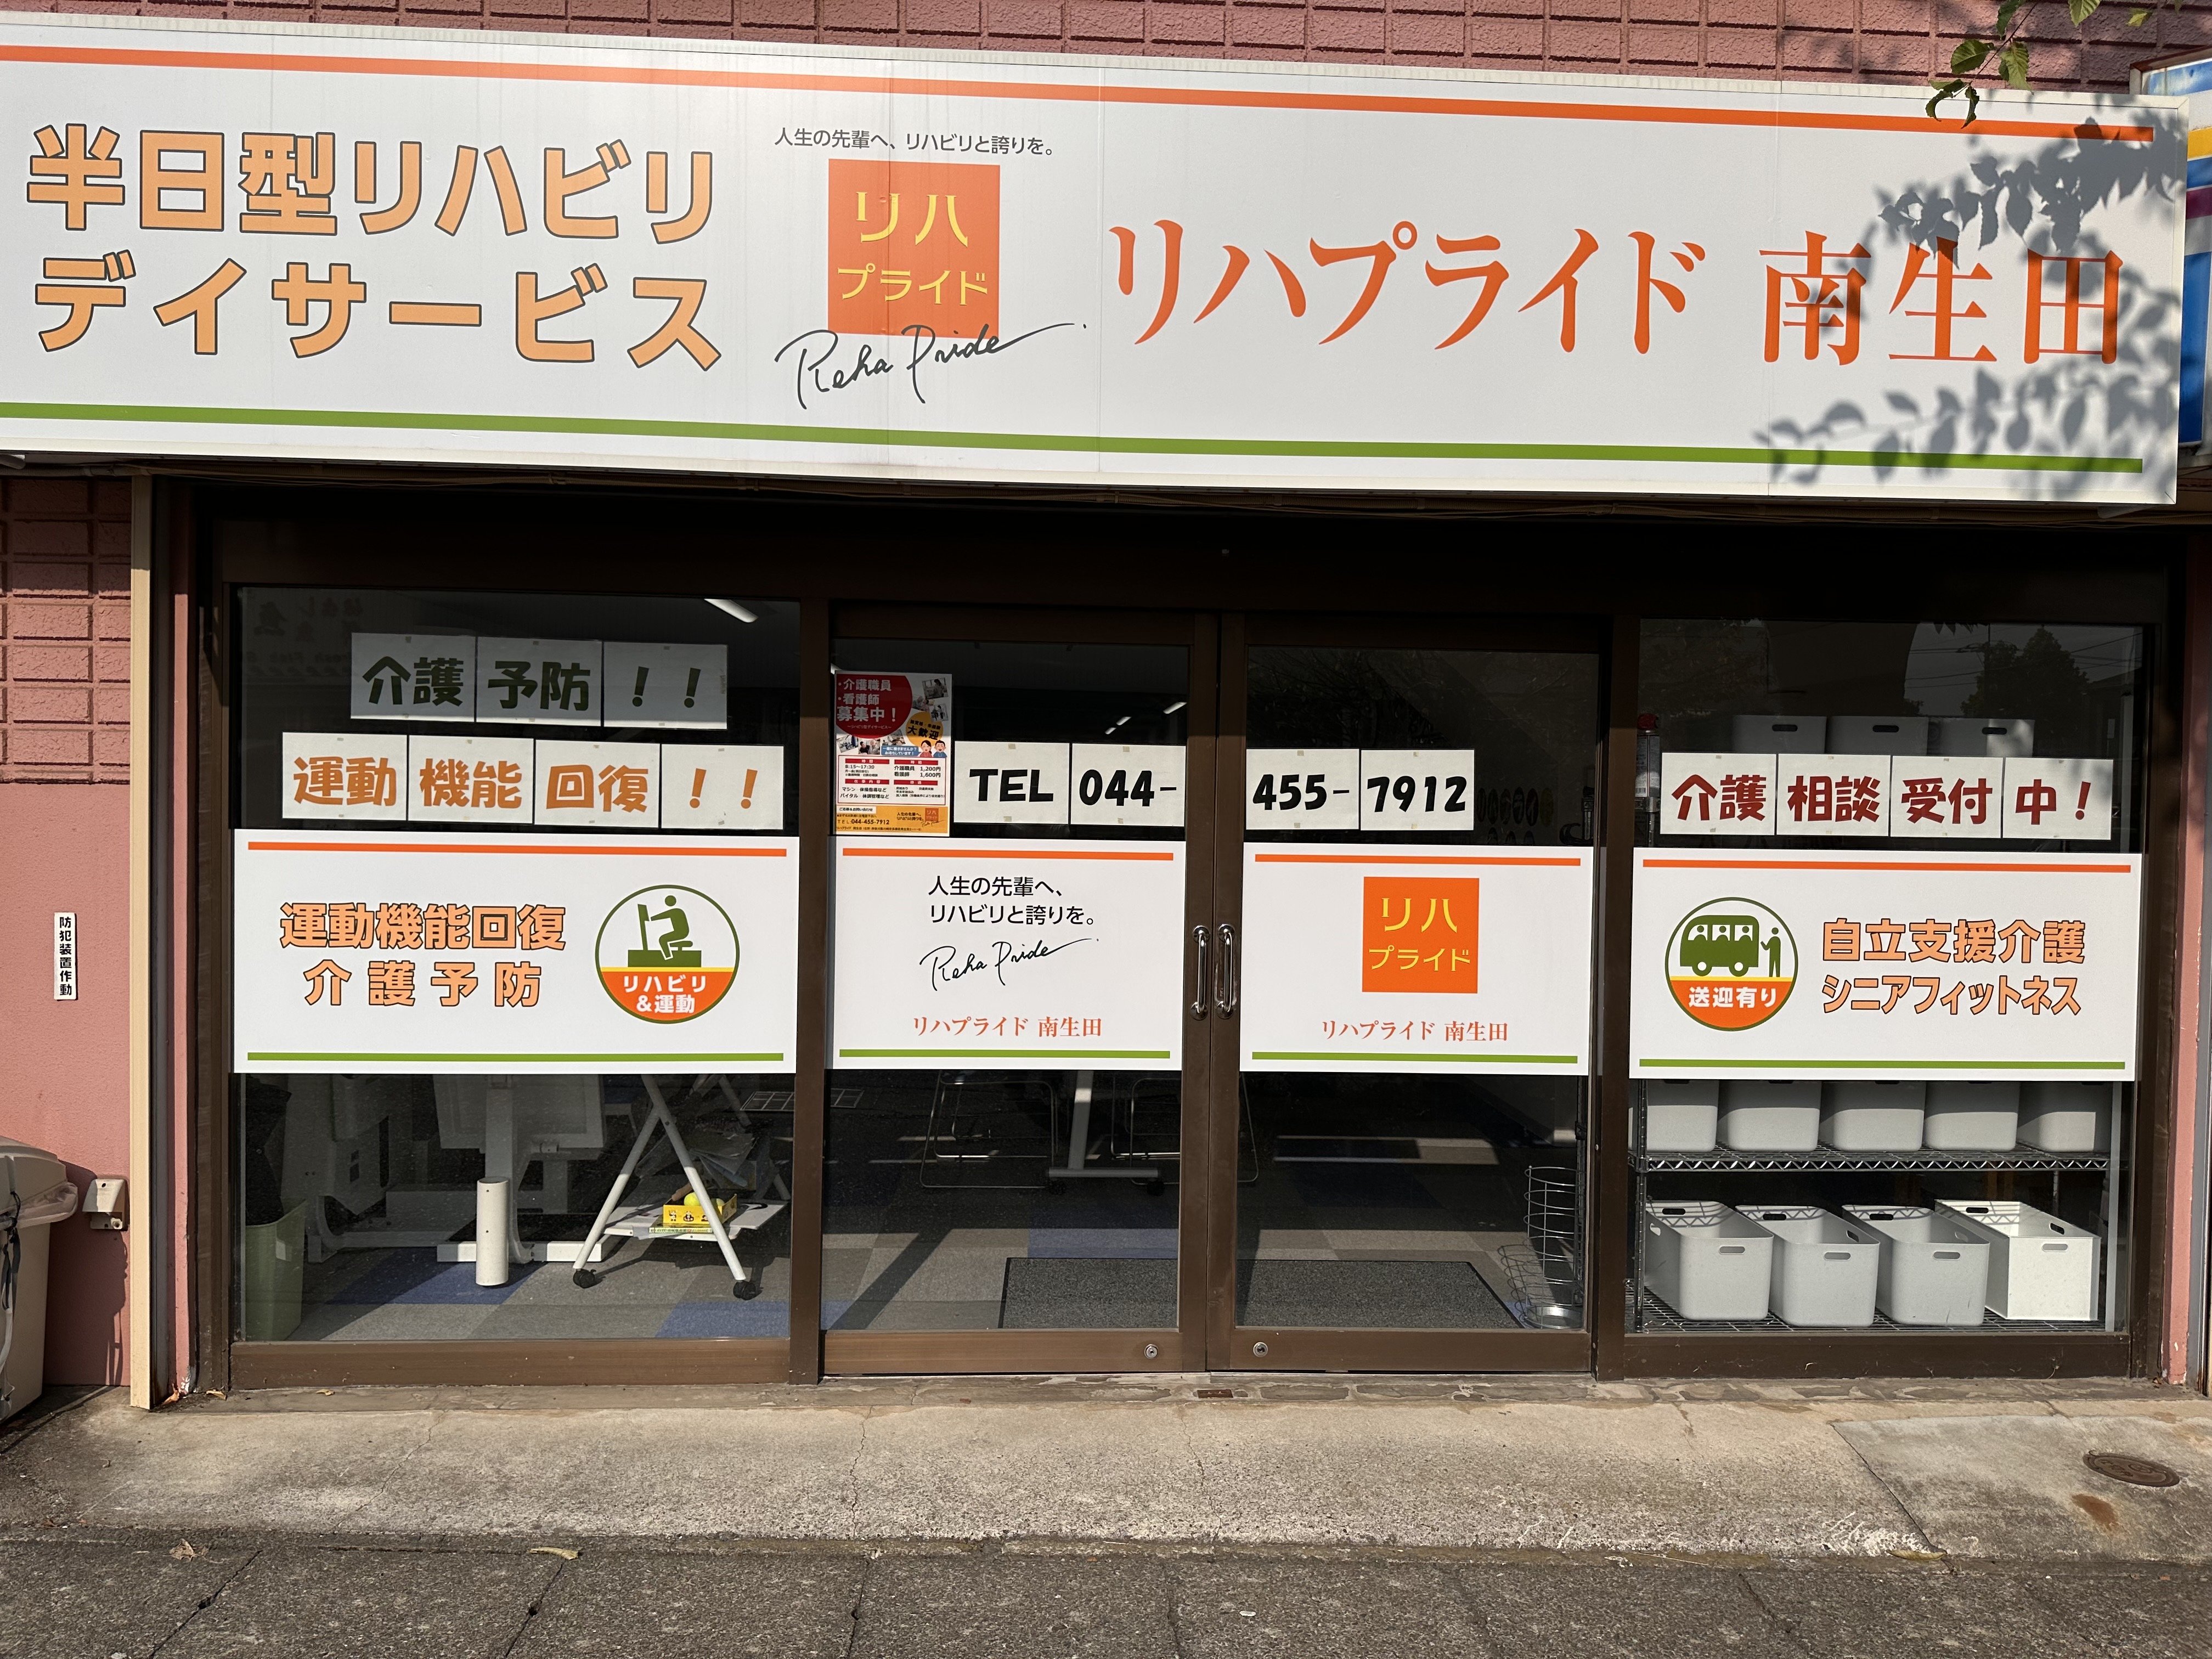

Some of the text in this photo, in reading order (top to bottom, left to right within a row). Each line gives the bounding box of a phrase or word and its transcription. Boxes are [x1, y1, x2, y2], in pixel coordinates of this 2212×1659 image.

[774, 127, 1054, 156] 人生の先輩へ、リハビリと誇りを。
[26, 123, 713, 245] 半日型リハビリ
[855, 191, 969, 248] リハ
[837, 262, 988, 306] プライド
[1108, 219, 2125, 366] リハプライド 南生田
[35, 250, 721, 371] デイサービス
[774, 323, 1087, 410] Reha Pride
[837, 706, 896, 723] 募集中！
[907, 725, 940, 741] 大歓迎
[968, 769, 1054, 803] TEL
[927, 875, 1063, 897] 人生の先輩へ、
[280, 902, 566, 951] 運動機能回復
[930, 904, 1094, 926] リハビリと誇りを。
[1381, 898, 1458, 933] リハ
[59, 916, 72, 996] 防犯装置作動
[1368, 944, 1471, 972] プライド
[1821, 917, 2086, 965] 自立支援介護
[919, 938, 1099, 991] Reha Pride
[303, 960, 542, 1008] 介護予防
[623, 974, 707, 994] リハビリ
[1688, 985, 1777, 1009] 送迎有り
[1821, 974, 2081, 1016] シニアフィットネス
[635, 994, 697, 1015] &運動
[913, 1016, 1103, 1038] リハプライド 南生田
[1322, 1020, 1509, 1042] リハプライド 南生田
